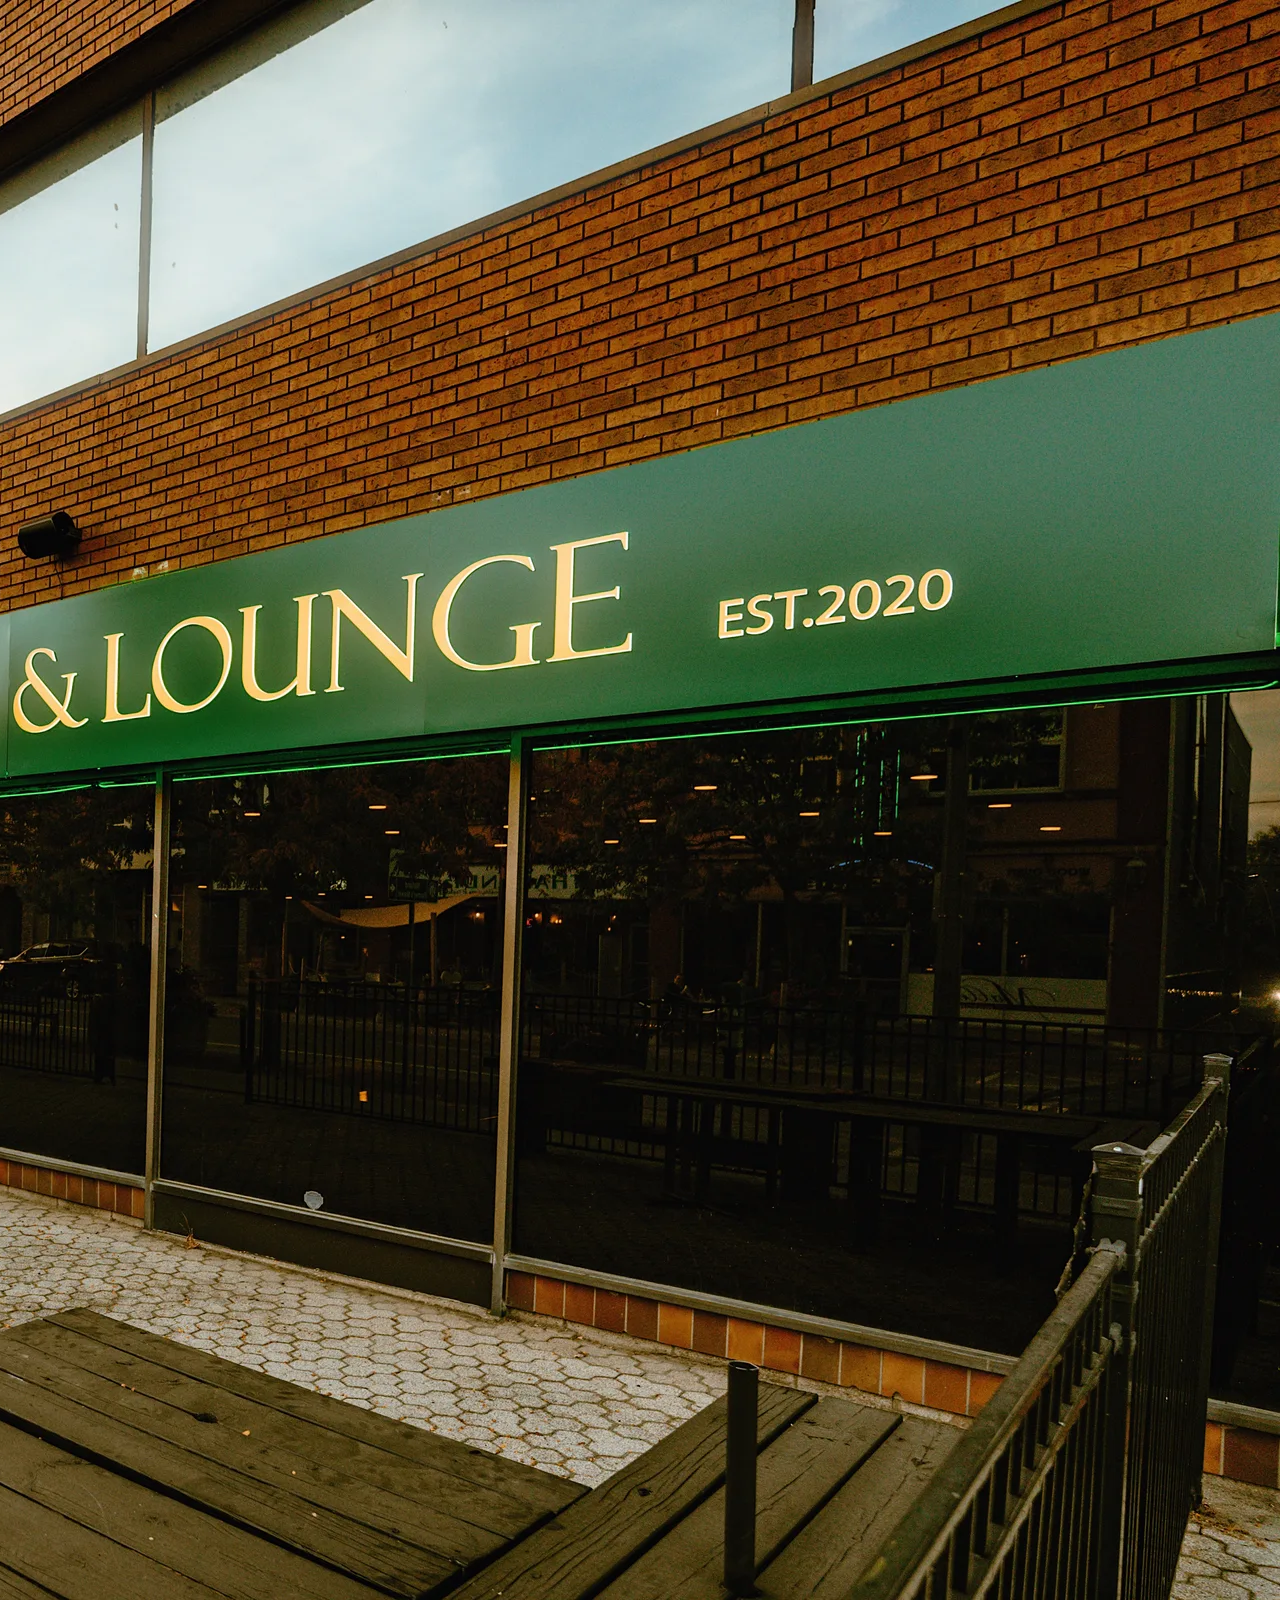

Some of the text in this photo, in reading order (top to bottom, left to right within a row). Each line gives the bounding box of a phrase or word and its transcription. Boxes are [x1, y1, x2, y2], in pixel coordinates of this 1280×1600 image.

[13, 648, 88, 734] &
[102, 531, 633, 723] LOUNGE
[718, 568, 954, 640] EST.2020
